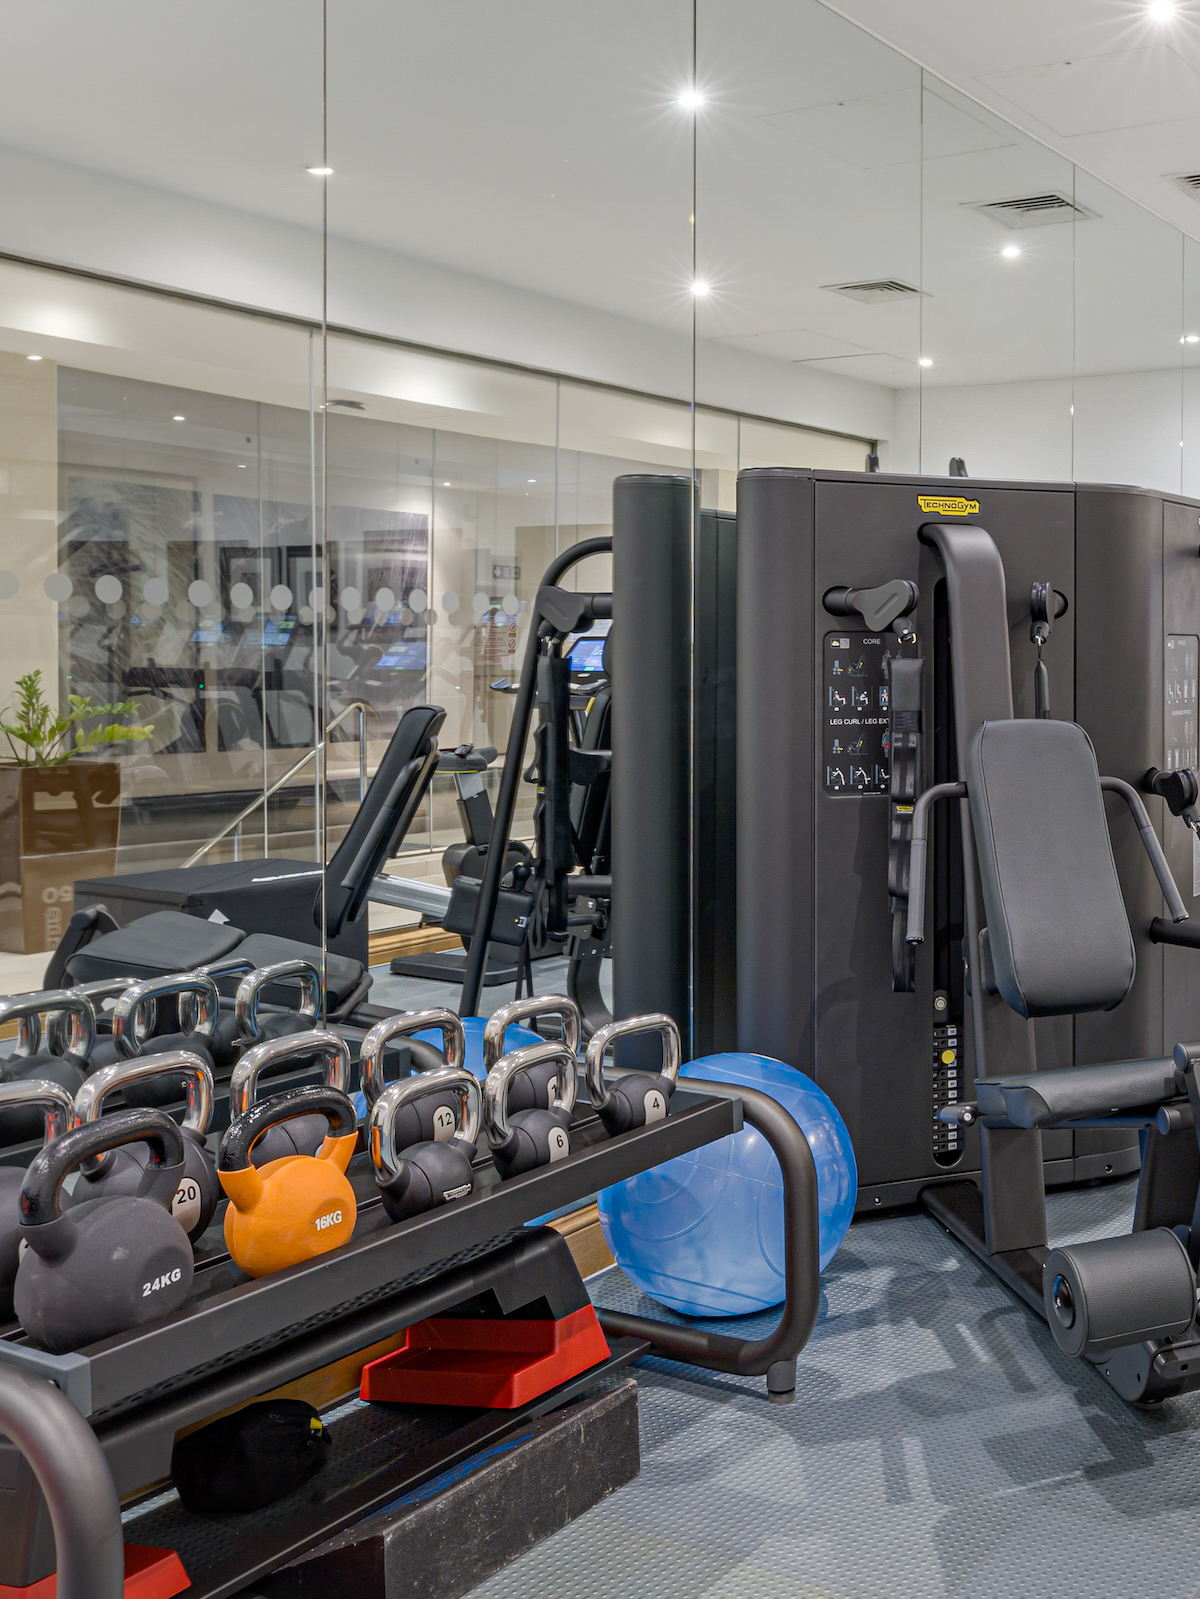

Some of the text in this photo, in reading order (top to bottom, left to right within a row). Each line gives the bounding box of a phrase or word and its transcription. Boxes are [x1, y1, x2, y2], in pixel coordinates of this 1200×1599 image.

[865, 717, 878, 725] LEG
[652, 1097, 660, 1110] 4
[437, 1112, 453, 1128] 12
[556, 1134, 564, 1148] 6
[176, 1185, 197, 1206] 20
[315, 1209, 343, 1232] 16KG
[142, 1267, 183, 1298] 24KG
